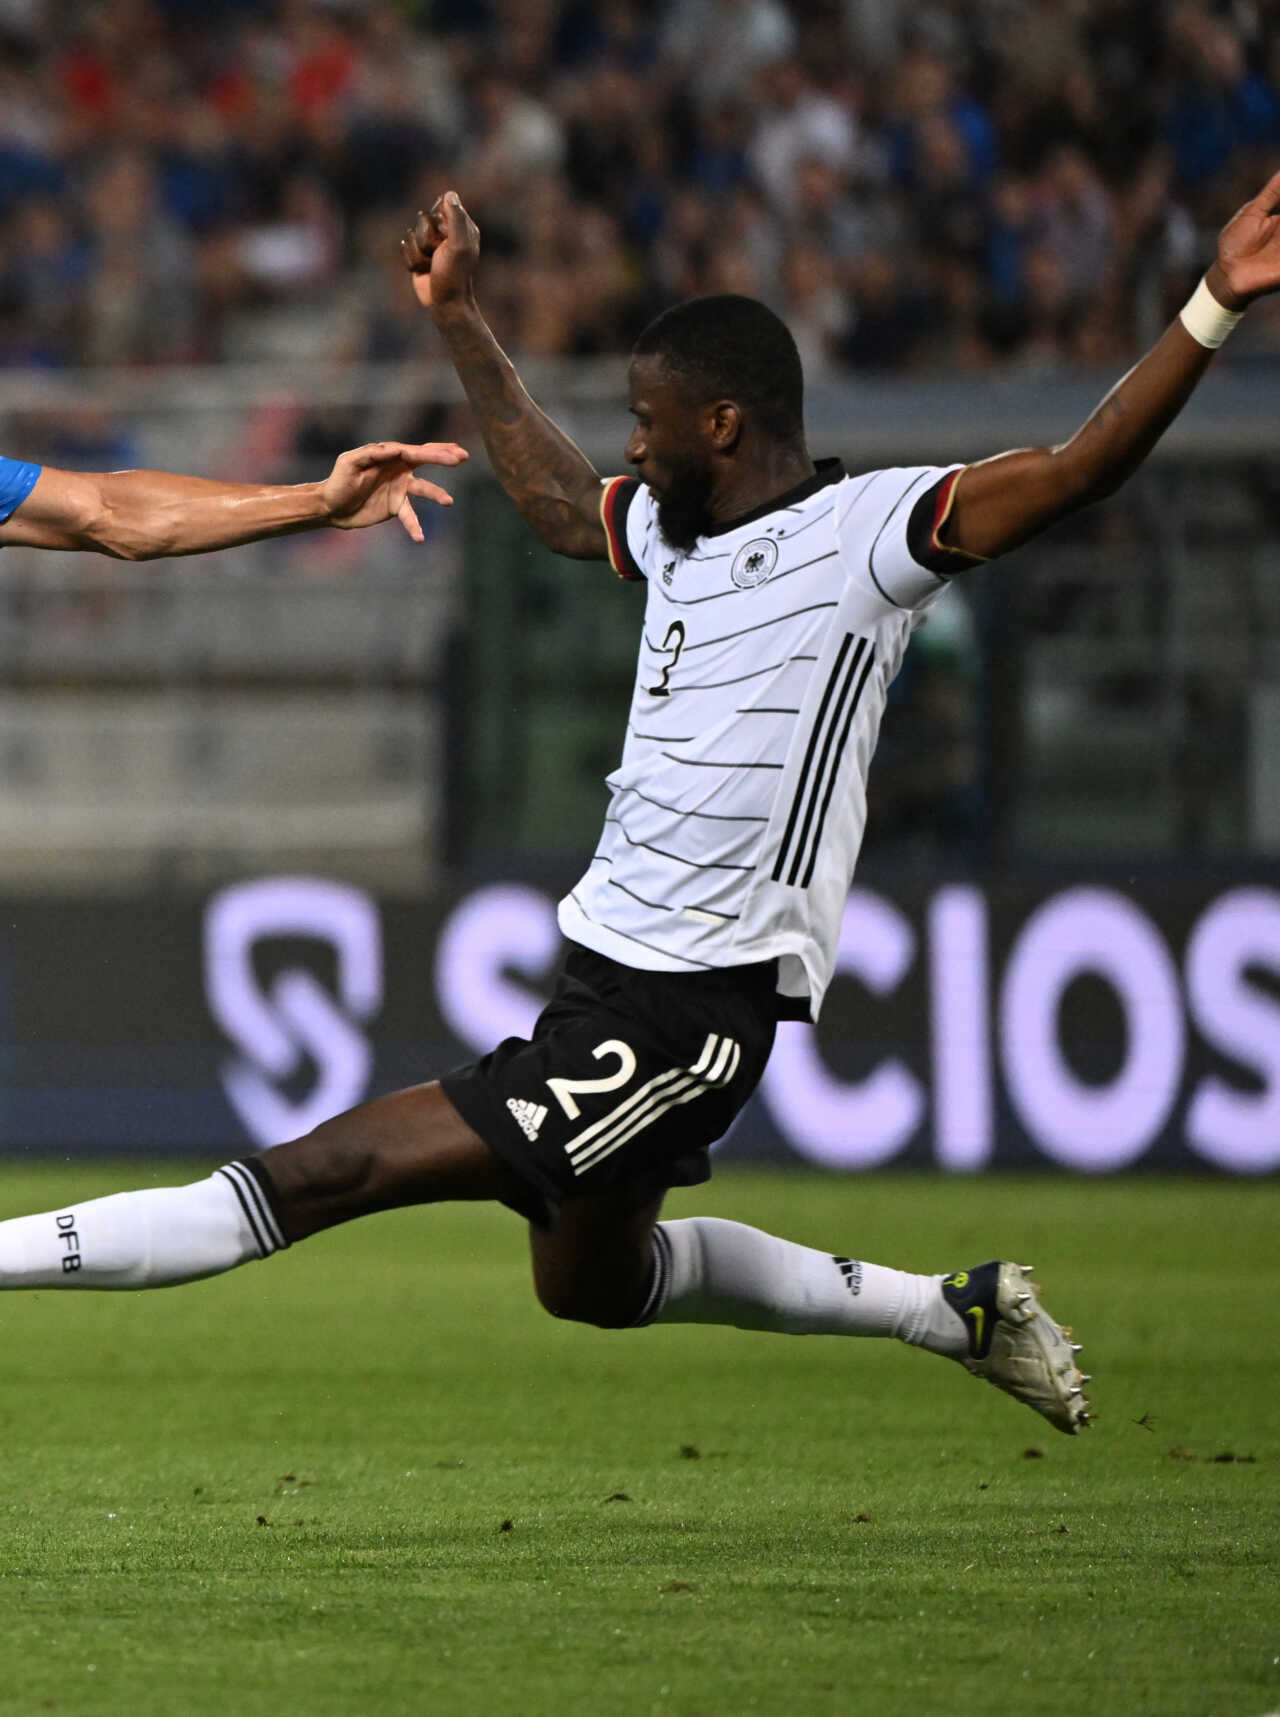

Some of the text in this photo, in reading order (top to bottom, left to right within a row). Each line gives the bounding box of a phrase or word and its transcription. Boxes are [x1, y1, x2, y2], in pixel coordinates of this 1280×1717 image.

[648, 619, 686, 697] 2
[434, 882, 1280, 1174] SCIOS
[545, 1038, 637, 1121] 2
[506, 1097, 539, 1142] adidas
[55, 1213, 81, 1274] DFB
